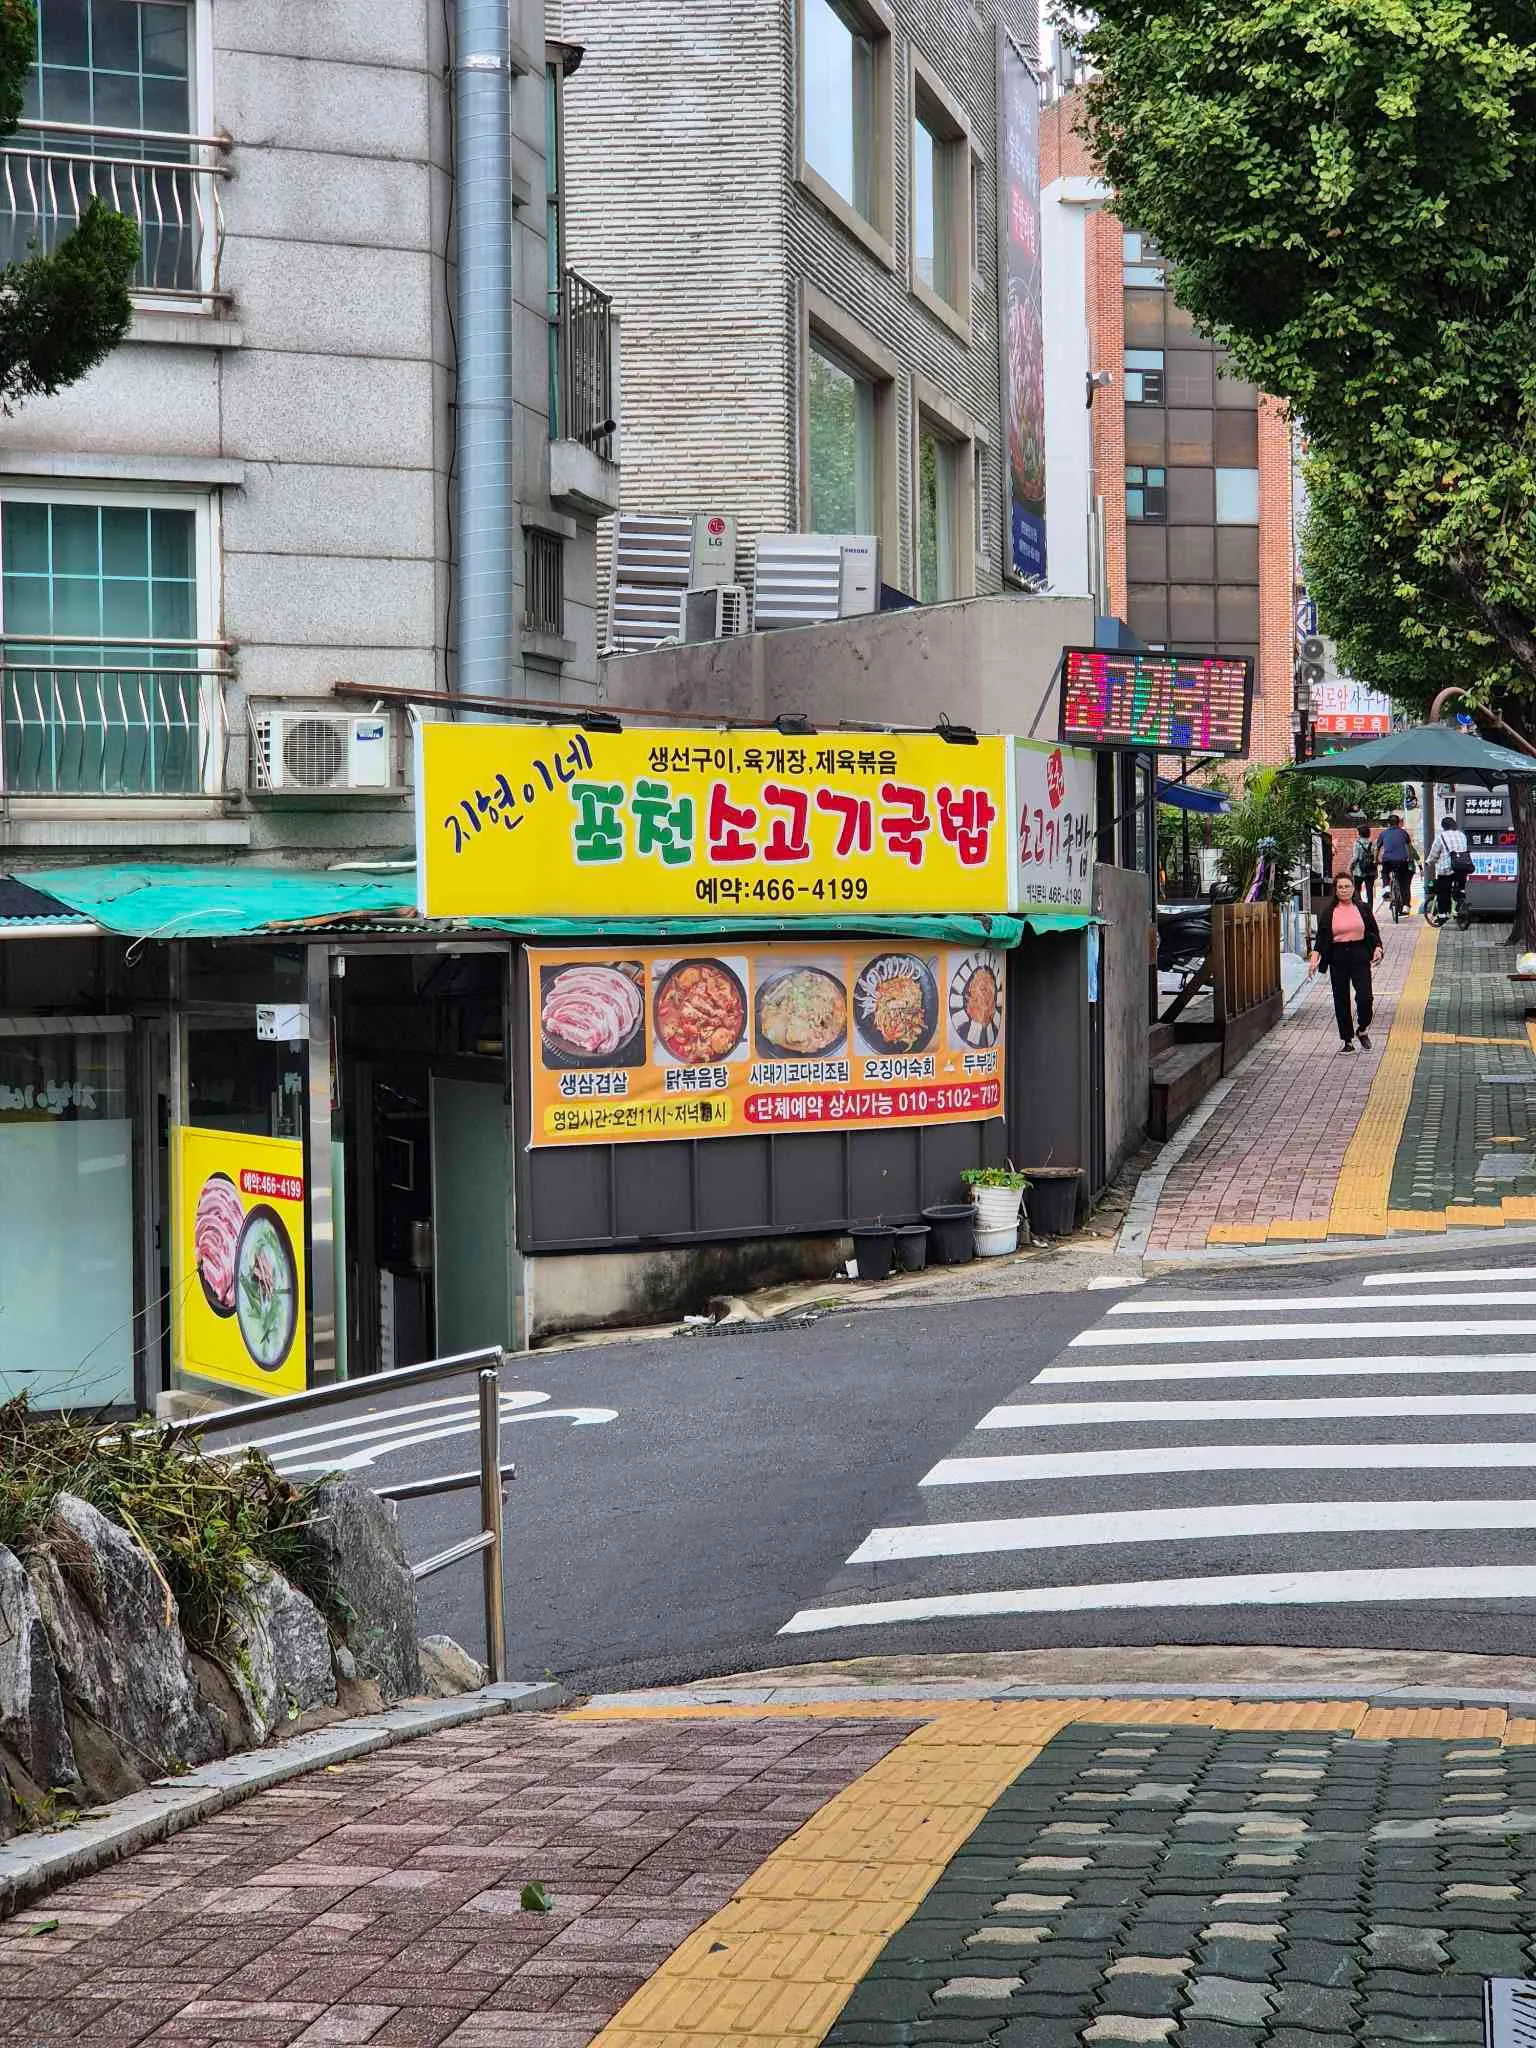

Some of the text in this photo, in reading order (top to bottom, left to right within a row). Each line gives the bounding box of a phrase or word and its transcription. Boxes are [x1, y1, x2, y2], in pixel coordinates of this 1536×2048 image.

[708, 538, 723, 547] LG
[648, 747, 898, 775] 생선구이,육개장,제육볶음
[444, 734, 593, 854] 지연이네
[571, 779, 996, 865] 포천 소고기국밥
[696, 877, 868, 904] 예약:466-4199
[1048, 886, 1082, 905] 466-4199
[665, 1066, 728, 1091] 닭볶음탕
[750, 1061, 849, 1085] 시래기코다리조림
[864, 1056, 935, 1080] 오징어숙회
[560, 1072, 628, 1096] 생삼겹살
[757, 1096, 823, 1120] 단체예약
[829, 1093, 893, 1116] 상시가능
[243, 1171, 301, 1199] 예약:466-4199
